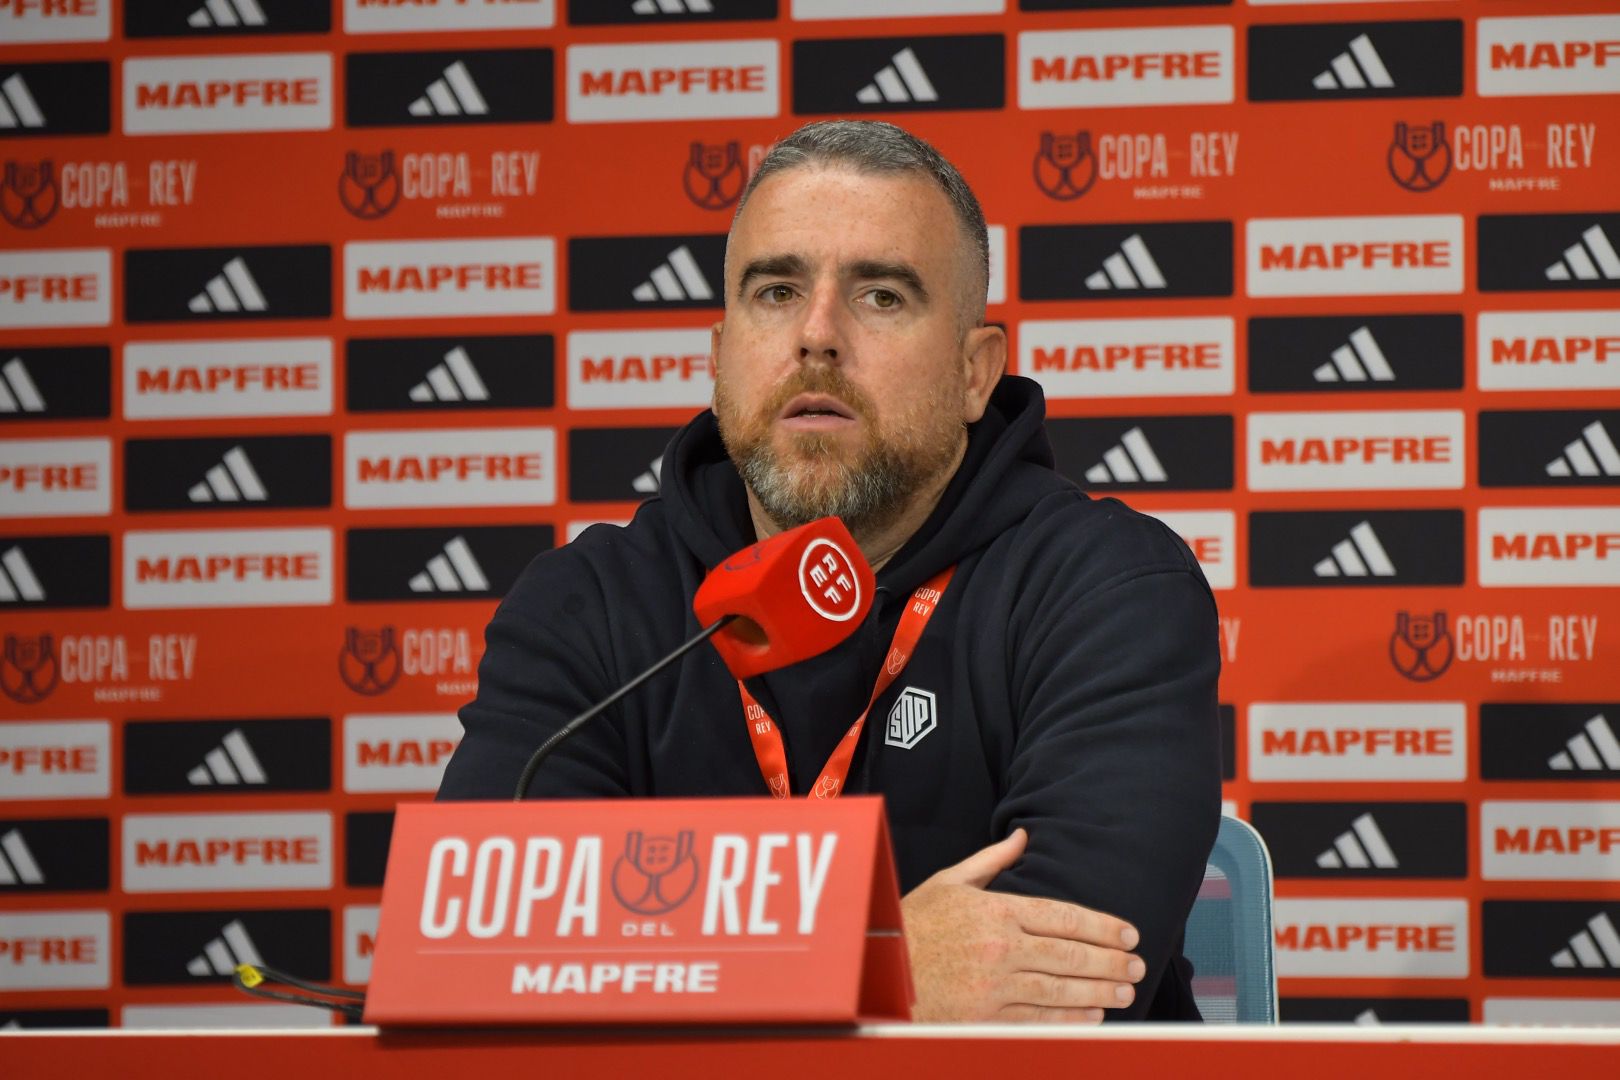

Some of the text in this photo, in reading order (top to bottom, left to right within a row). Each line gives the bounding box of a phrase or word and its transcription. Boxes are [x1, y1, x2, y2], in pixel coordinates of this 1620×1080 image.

[1031, 52, 1220, 82] MAPFRE
[1490, 41, 1620, 70] MAPF
[135, 78, 318, 109] MAPFRE
[579, 66, 764, 97] MAPFRE
[1099, 131, 1240, 180] COPA REY
[1454, 123, 1596, 171] COPA REY
[61, 160, 198, 208] COPA REY
[402, 151, 540, 199] COPA REY
[1260, 241, 1450, 271] MAPFRE
[357, 263, 541, 293] MAPFRE
[1032, 343, 1220, 373] MAPFRE
[1491, 336, 1620, 365] MAPF
[135, 364, 318, 394] MAPFRE
[580, 355, 716, 382] MAPF
[1260, 436, 1451, 465] MAPFRE
[357, 454, 541, 483] MAPFRE
[1491, 533, 1620, 561] MAPF
[135, 554, 318, 583] MAPFRE
[912, 601, 931, 616] REY
[914, 587, 941, 606] COPA
[402, 628, 472, 676] COPA
[1455, 614, 1599, 662] COPA REY
[60, 634, 198, 682] COPA REY
[755, 720, 771, 735] REY
[1262, 728, 1453, 756] MAPFRE
[135, 837, 319, 867] MAPFRE
[1494, 826, 1620, 855] MAPF
[419, 832, 839, 939] COPA DEL REY
[1275, 923, 1456, 952] MAPFRE
[511, 962, 720, 994] MAPFRE
